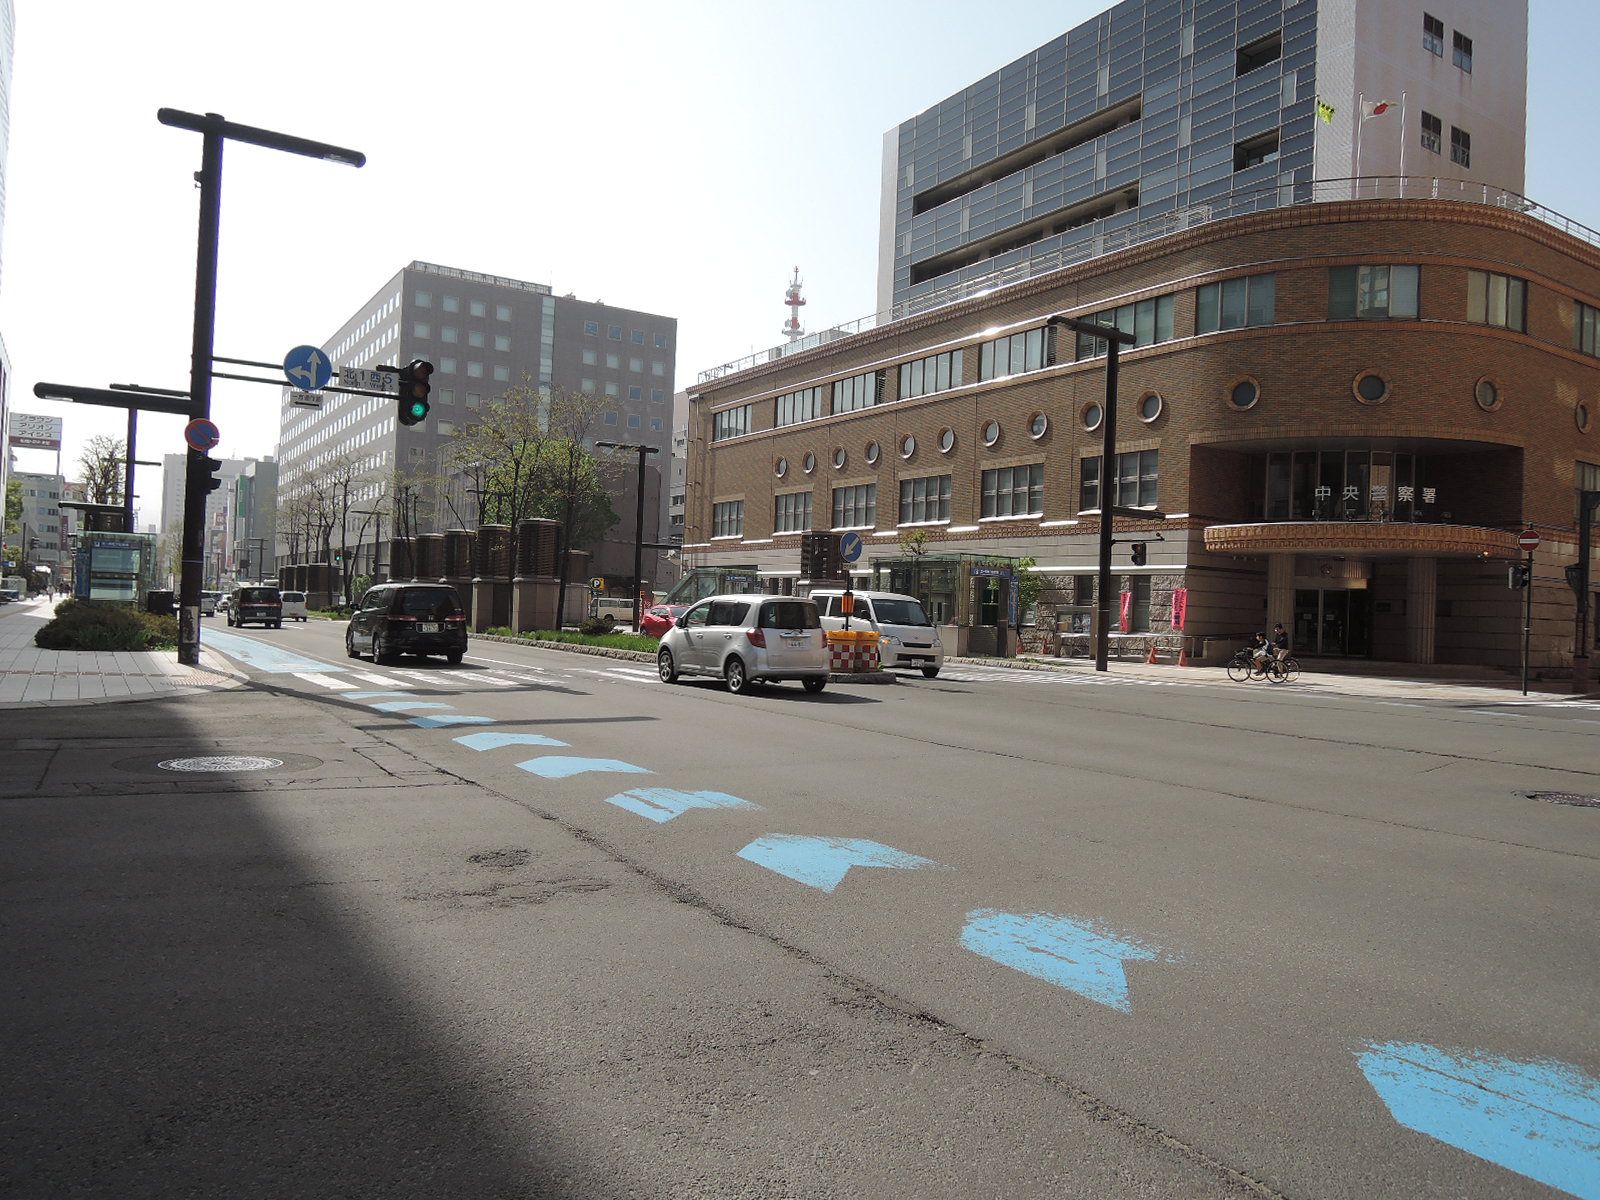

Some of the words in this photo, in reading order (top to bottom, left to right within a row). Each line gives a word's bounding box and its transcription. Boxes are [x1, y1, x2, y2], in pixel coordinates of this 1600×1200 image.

[1315, 485, 1437, 504] 中央警察署
